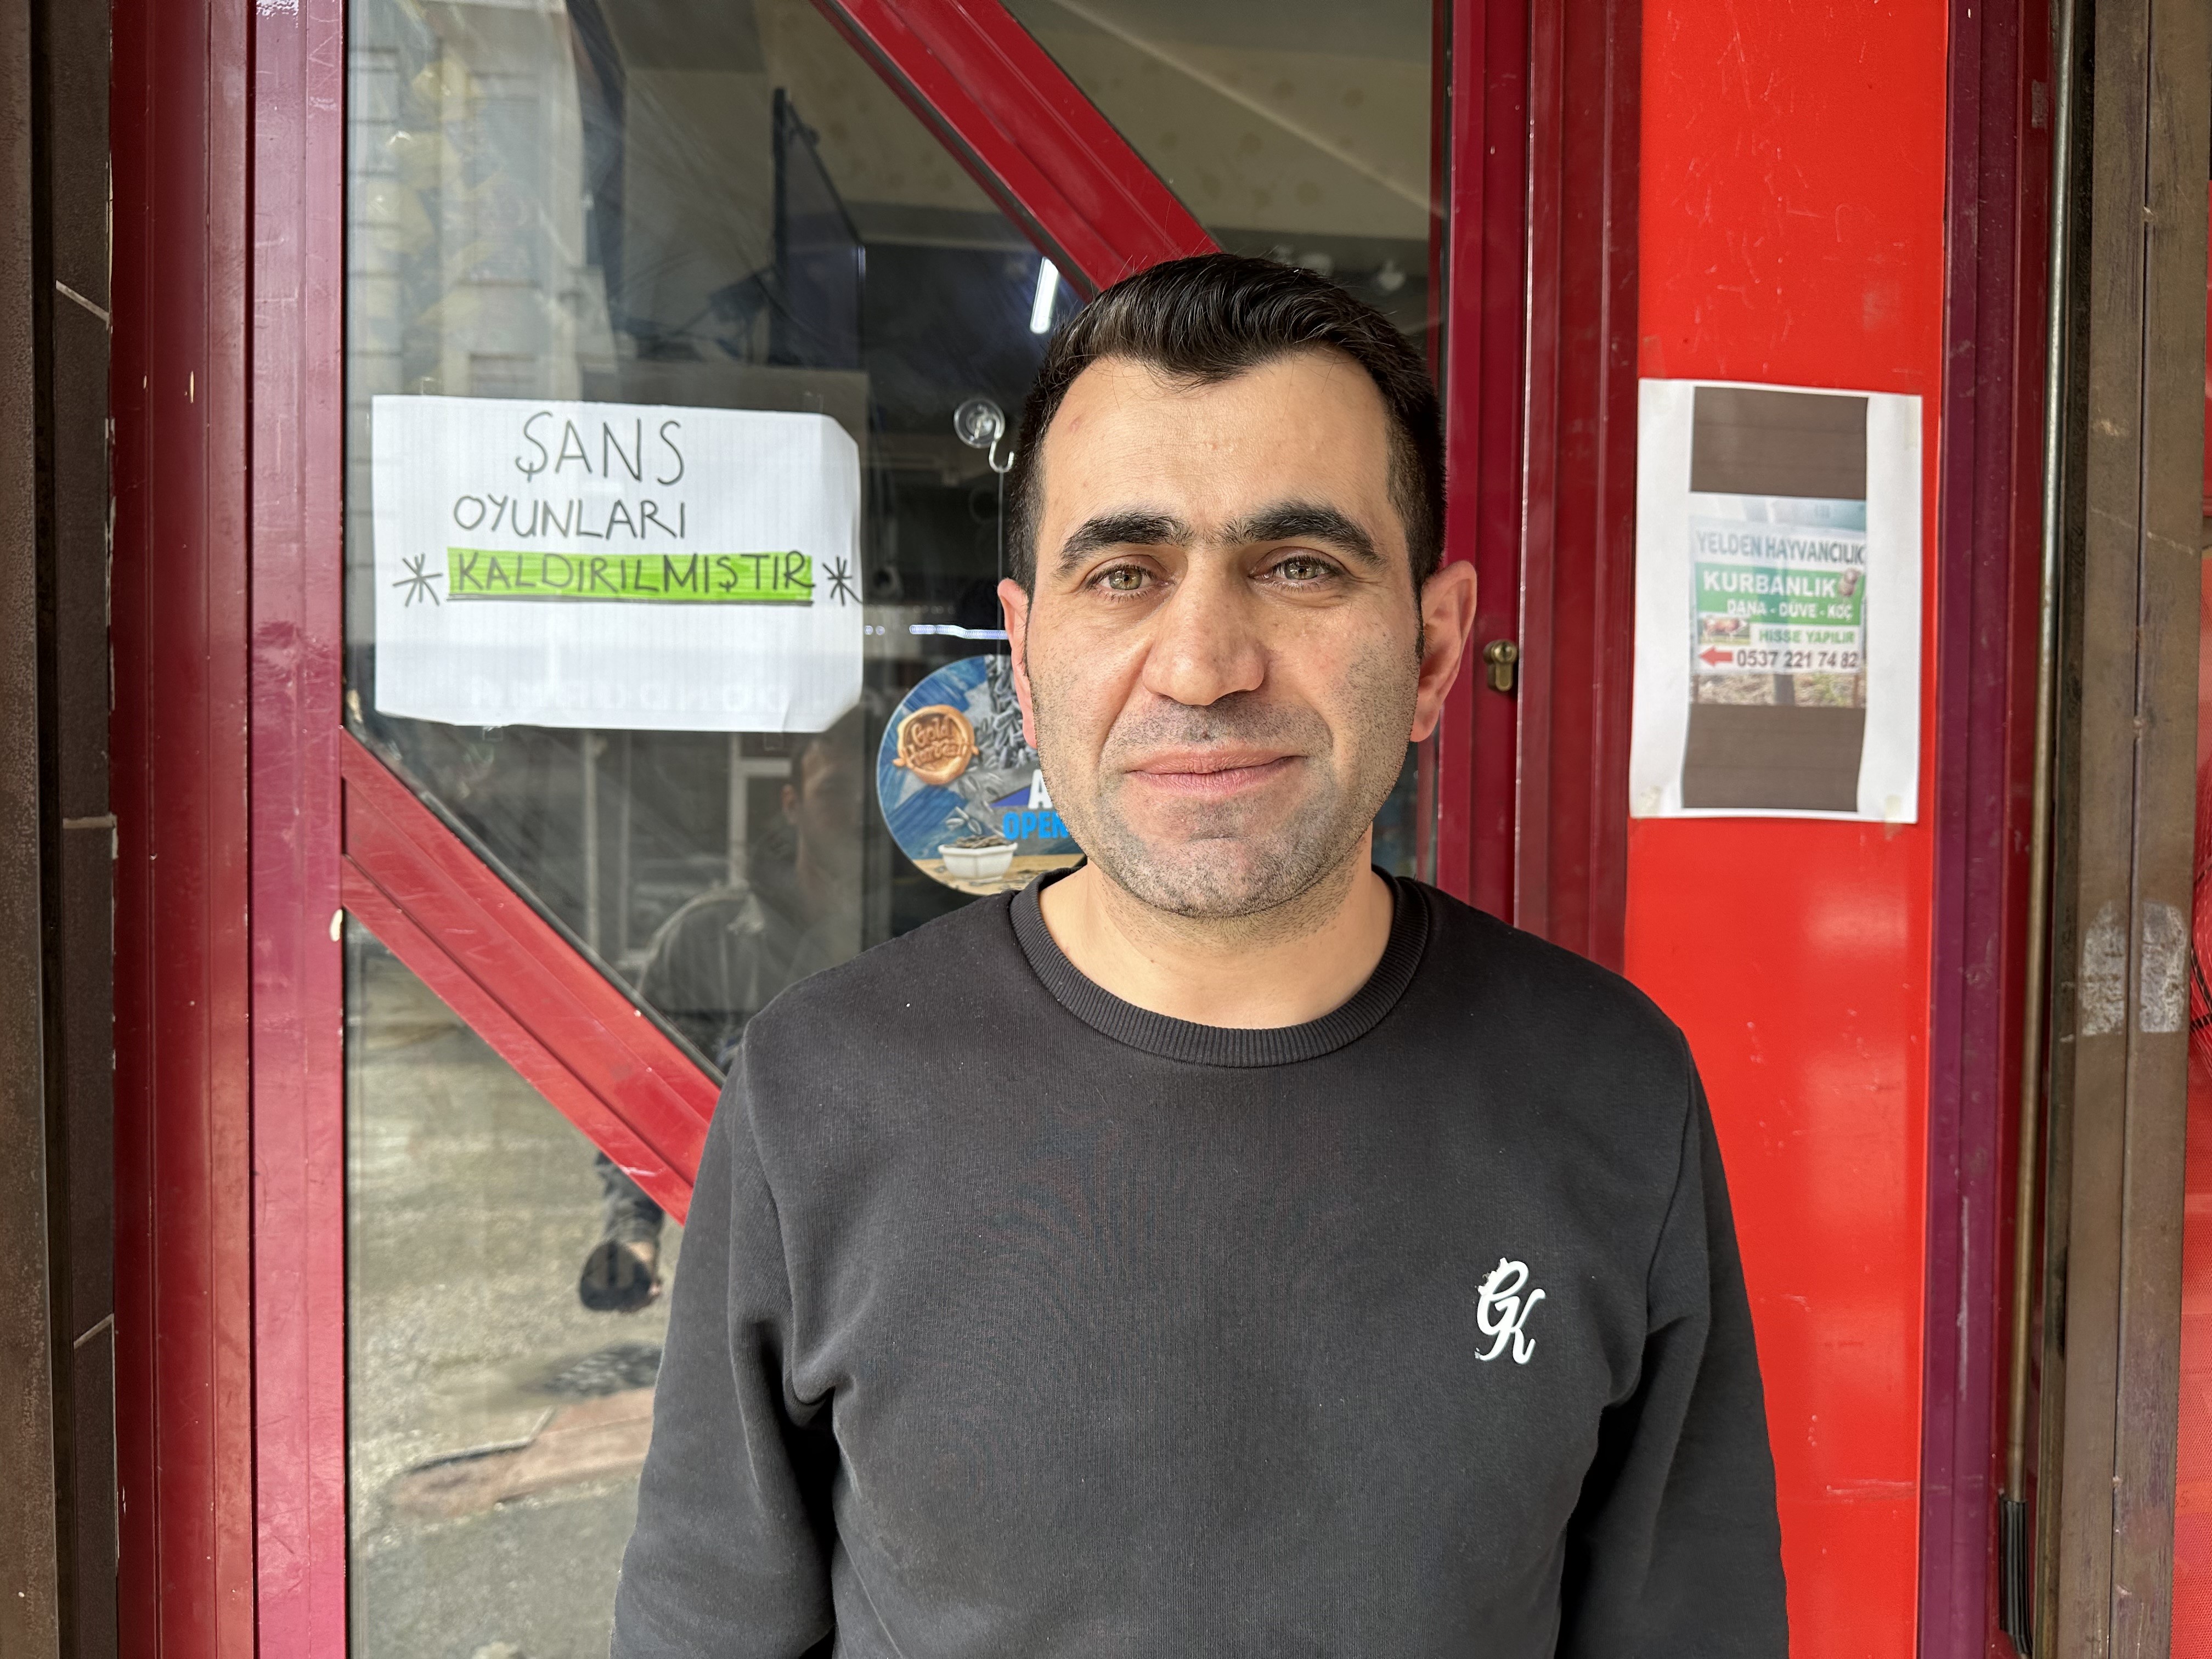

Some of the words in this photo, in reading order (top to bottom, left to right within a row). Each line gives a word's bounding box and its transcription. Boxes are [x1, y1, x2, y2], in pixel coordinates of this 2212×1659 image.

[515, 411, 685, 486] ŞANS
[453, 495, 686, 540] OYUNLARI
[1696, 530, 1762, 558] YELDEN
[458, 550, 816, 594] KALDIRILMIŞTIR
[1703, 570, 1836, 597] KURBANLIK
[1727, 599, 1767, 616] DANA
[1779, 600, 1818, 618] DÜVE
[1806, 630, 1856, 645] YAPILIR
[1737, 649, 1779, 668] 0537
[1782, 650, 1812, 668] 221
[1817, 651, 1838, 668] 74
[1840, 652, 1859, 668] 82
